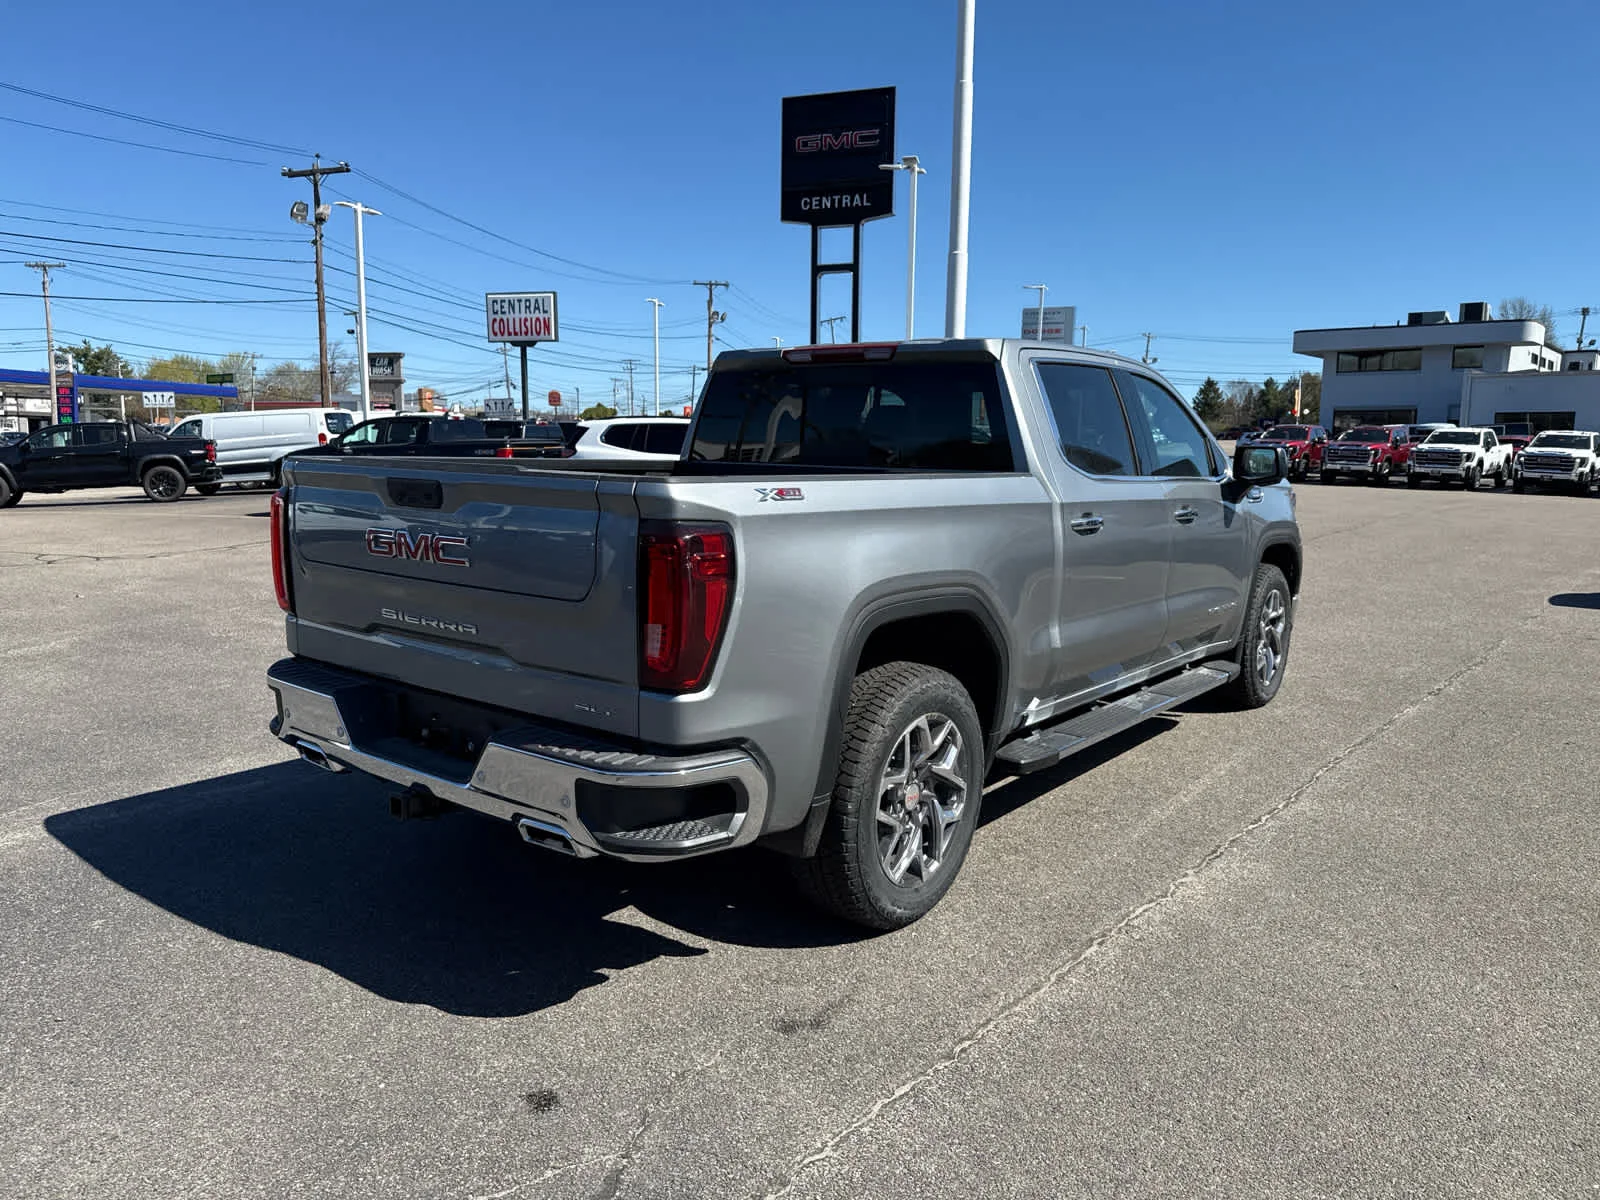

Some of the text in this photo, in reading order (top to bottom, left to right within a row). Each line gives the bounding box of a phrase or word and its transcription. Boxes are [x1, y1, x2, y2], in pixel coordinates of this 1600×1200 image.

[795, 129, 880, 152] GMC
[801, 193, 872, 210] CENTRAL
[491, 298, 549, 314] CENTRAL
[491, 316, 551, 336] COLLISION
[365, 527, 471, 567] GMC
[381, 608, 479, 635] SIERRA
